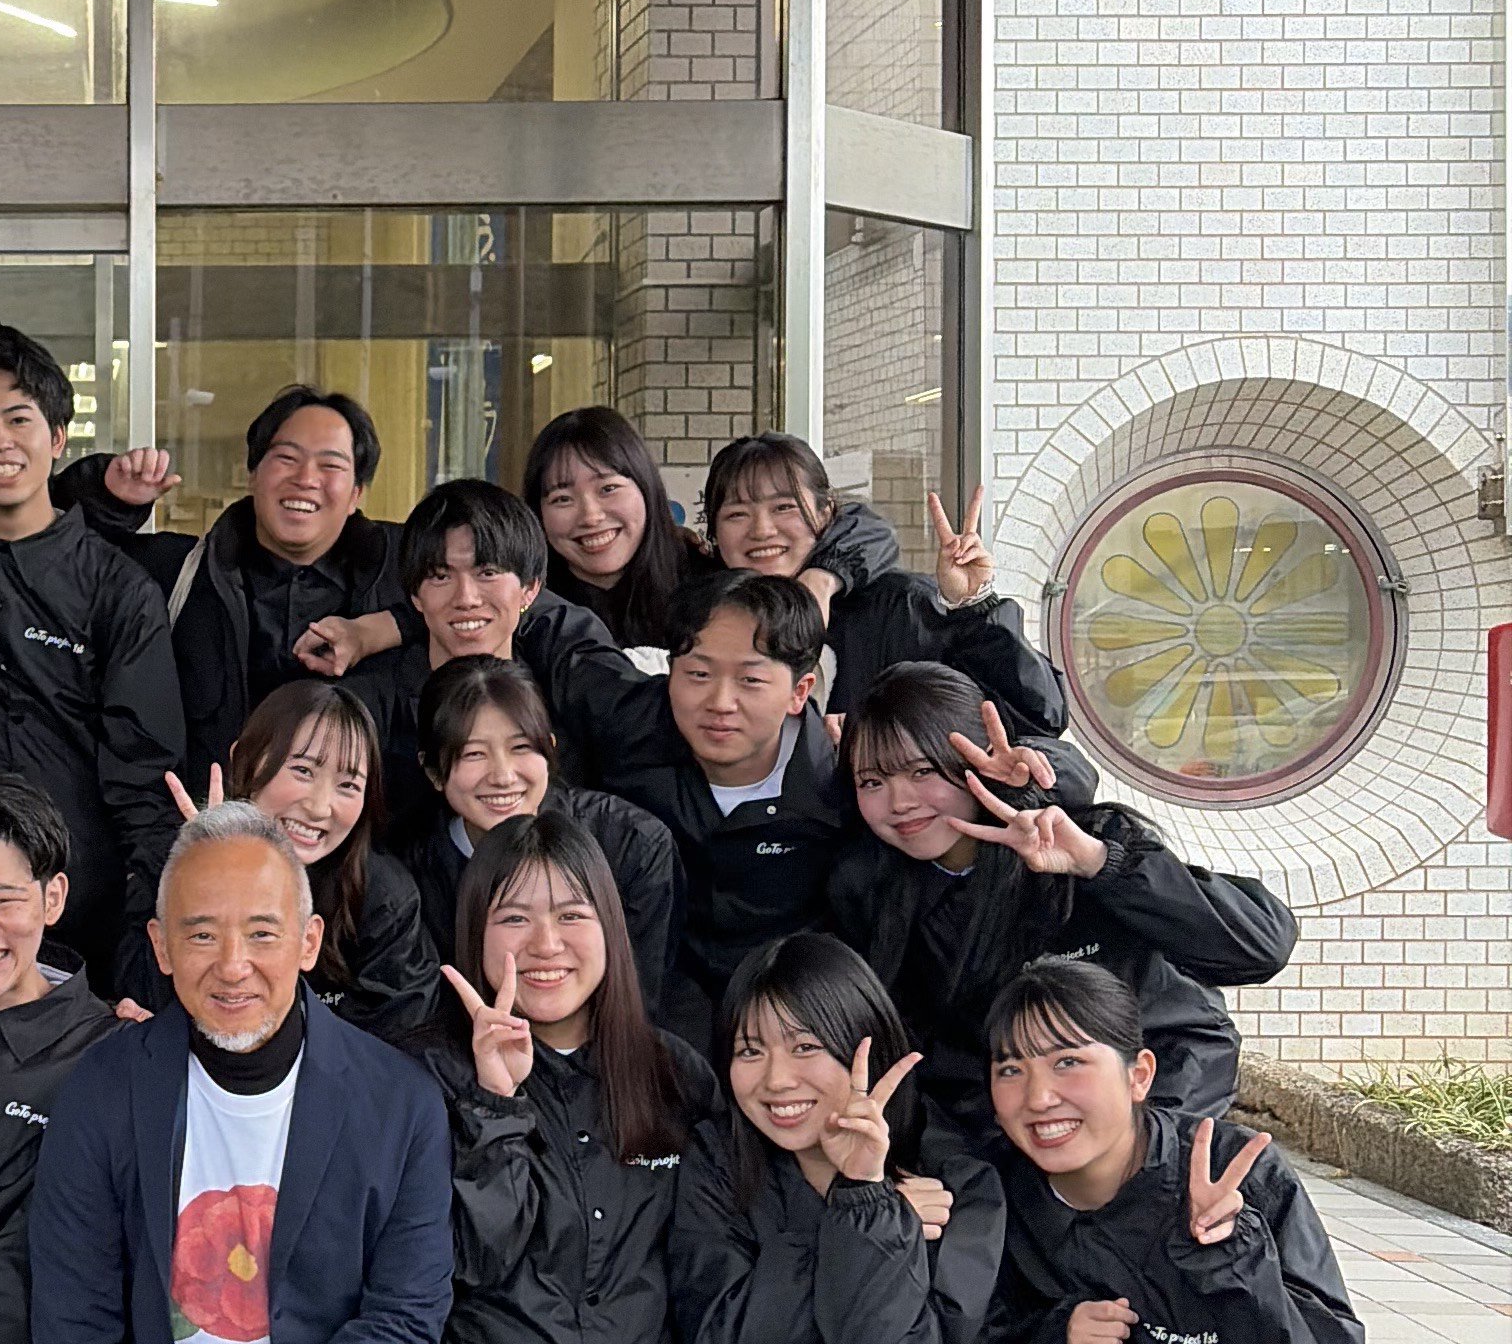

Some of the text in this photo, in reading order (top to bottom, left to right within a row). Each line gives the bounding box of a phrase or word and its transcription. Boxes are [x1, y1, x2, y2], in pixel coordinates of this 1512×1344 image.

[756, 841, 783, 855] GoTo
[5, 1101, 32, 1118] GoTo
[1203, 1331, 1219, 1344] 1st
